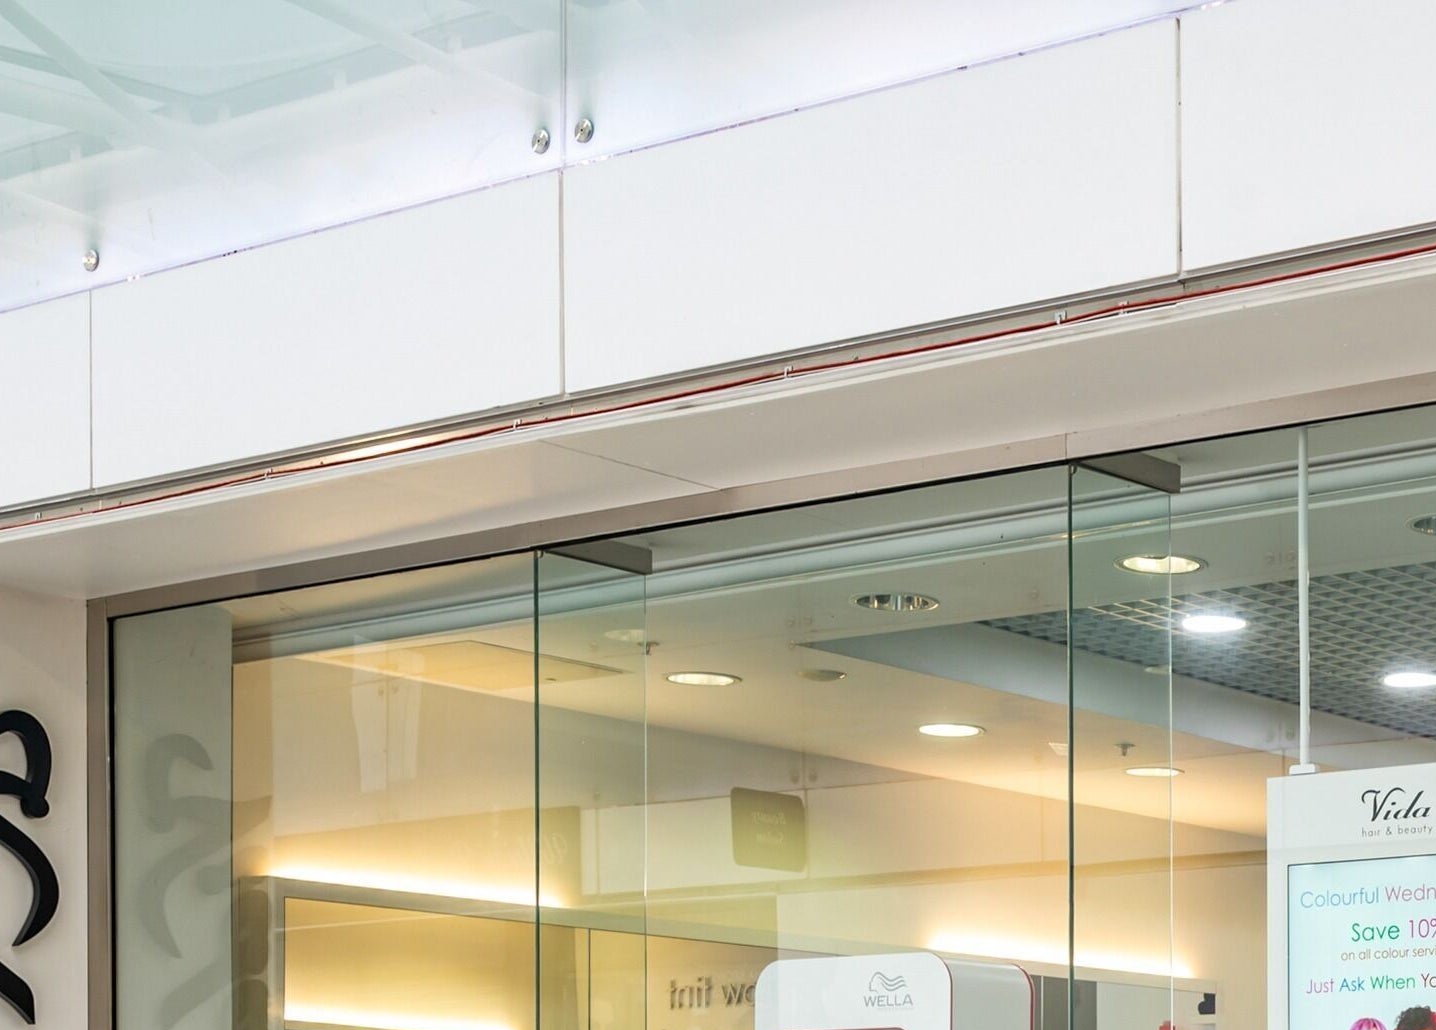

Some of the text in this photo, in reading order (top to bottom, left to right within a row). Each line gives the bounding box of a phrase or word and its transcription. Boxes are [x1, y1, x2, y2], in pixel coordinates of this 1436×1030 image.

[1361, 787, 1431, 822] Vida
[1361, 824, 1433, 838] hair & beauty
[1300, 887, 1380, 909] Colourful
[1351, 923, 1400, 942] Save
[1340, 951, 1356, 962] on
[1358, 948, 1372, 961] all
[1373, 946, 1410, 960] colour
[1306, 979, 1335, 995] Just
[1339, 977, 1366, 992] Ask
[1370, 975, 1416, 991] When
[863, 994, 914, 1008] WELLA
